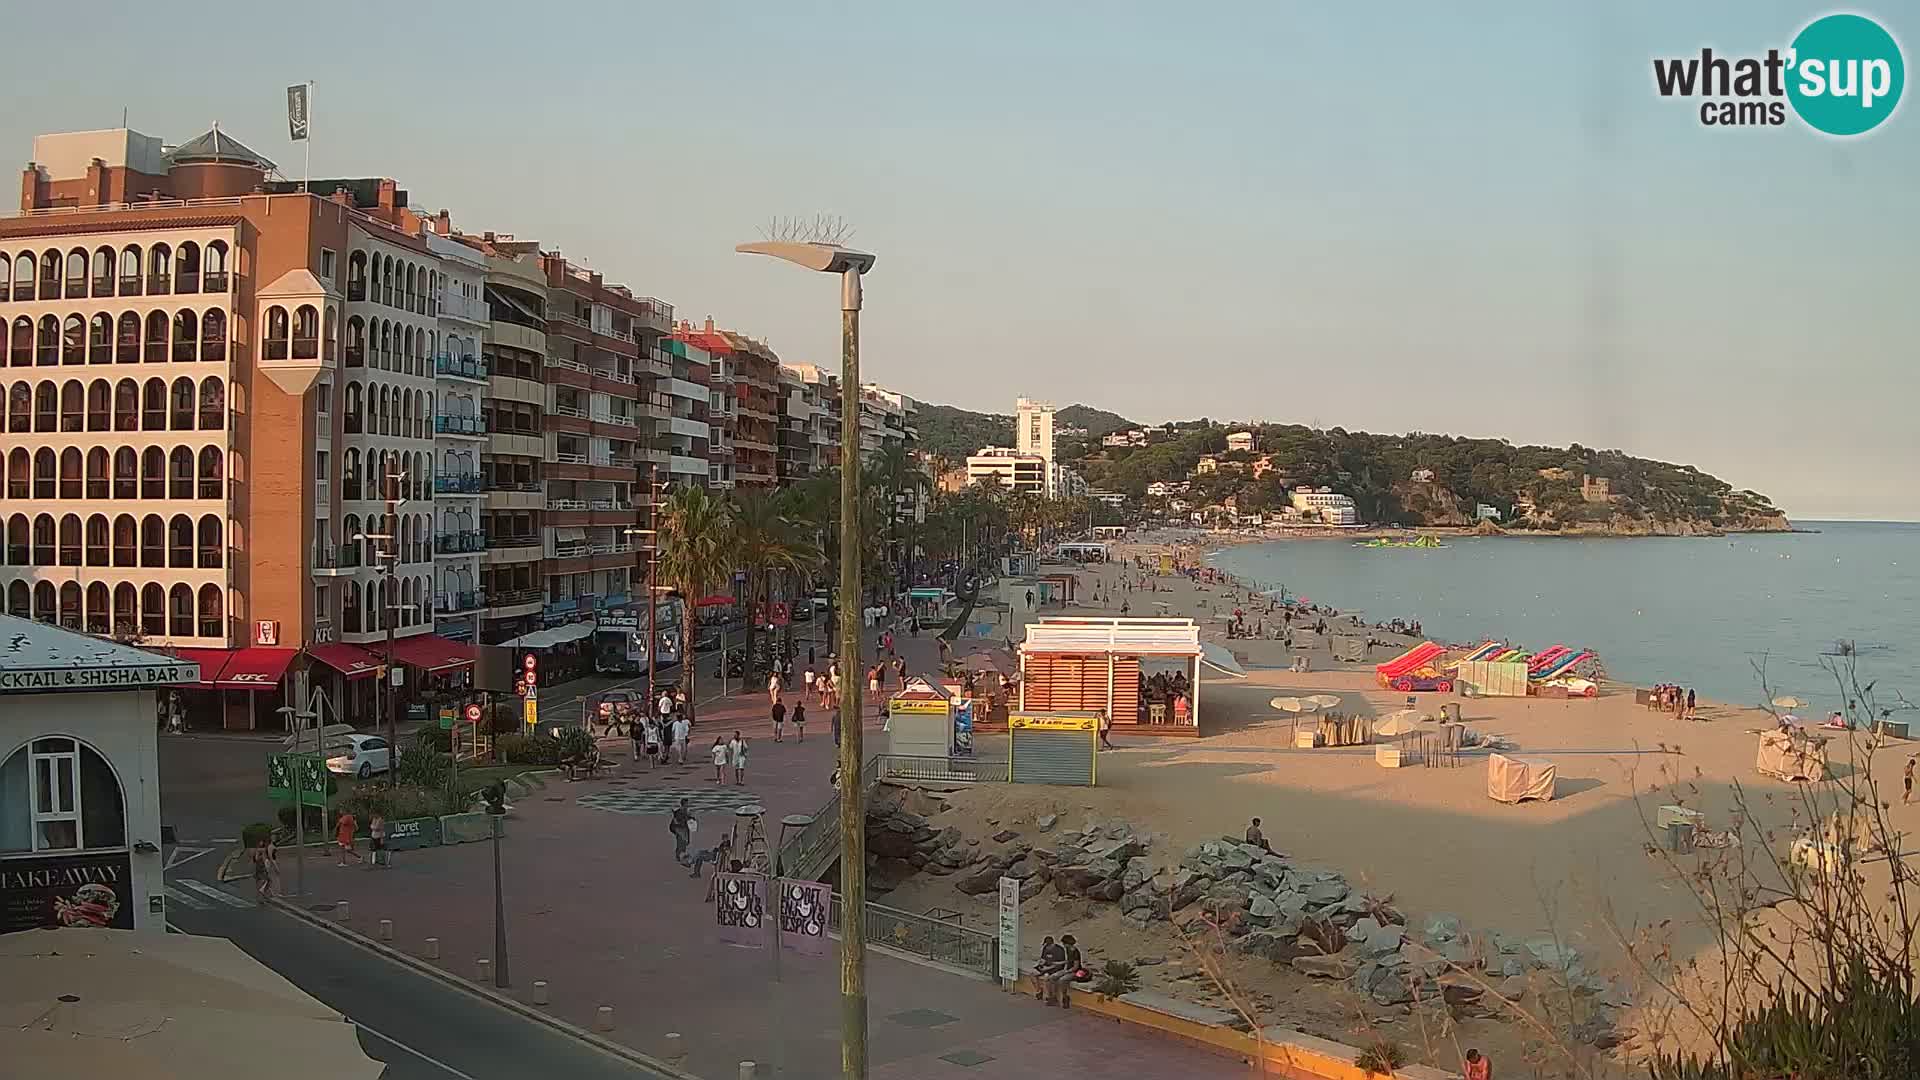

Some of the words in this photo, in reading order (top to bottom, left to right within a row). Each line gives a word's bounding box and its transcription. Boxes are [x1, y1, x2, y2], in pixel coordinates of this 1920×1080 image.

[315, 627, 333, 644] KFC
[64, 671, 76, 685] &
[80, 669, 141, 685] SHISHA
[145, 667, 179, 682] BAR
[231, 673, 269, 681] KFC
[394, 821, 420, 833] lloret
[0, 865, 121, 888] TAKEAWAY
